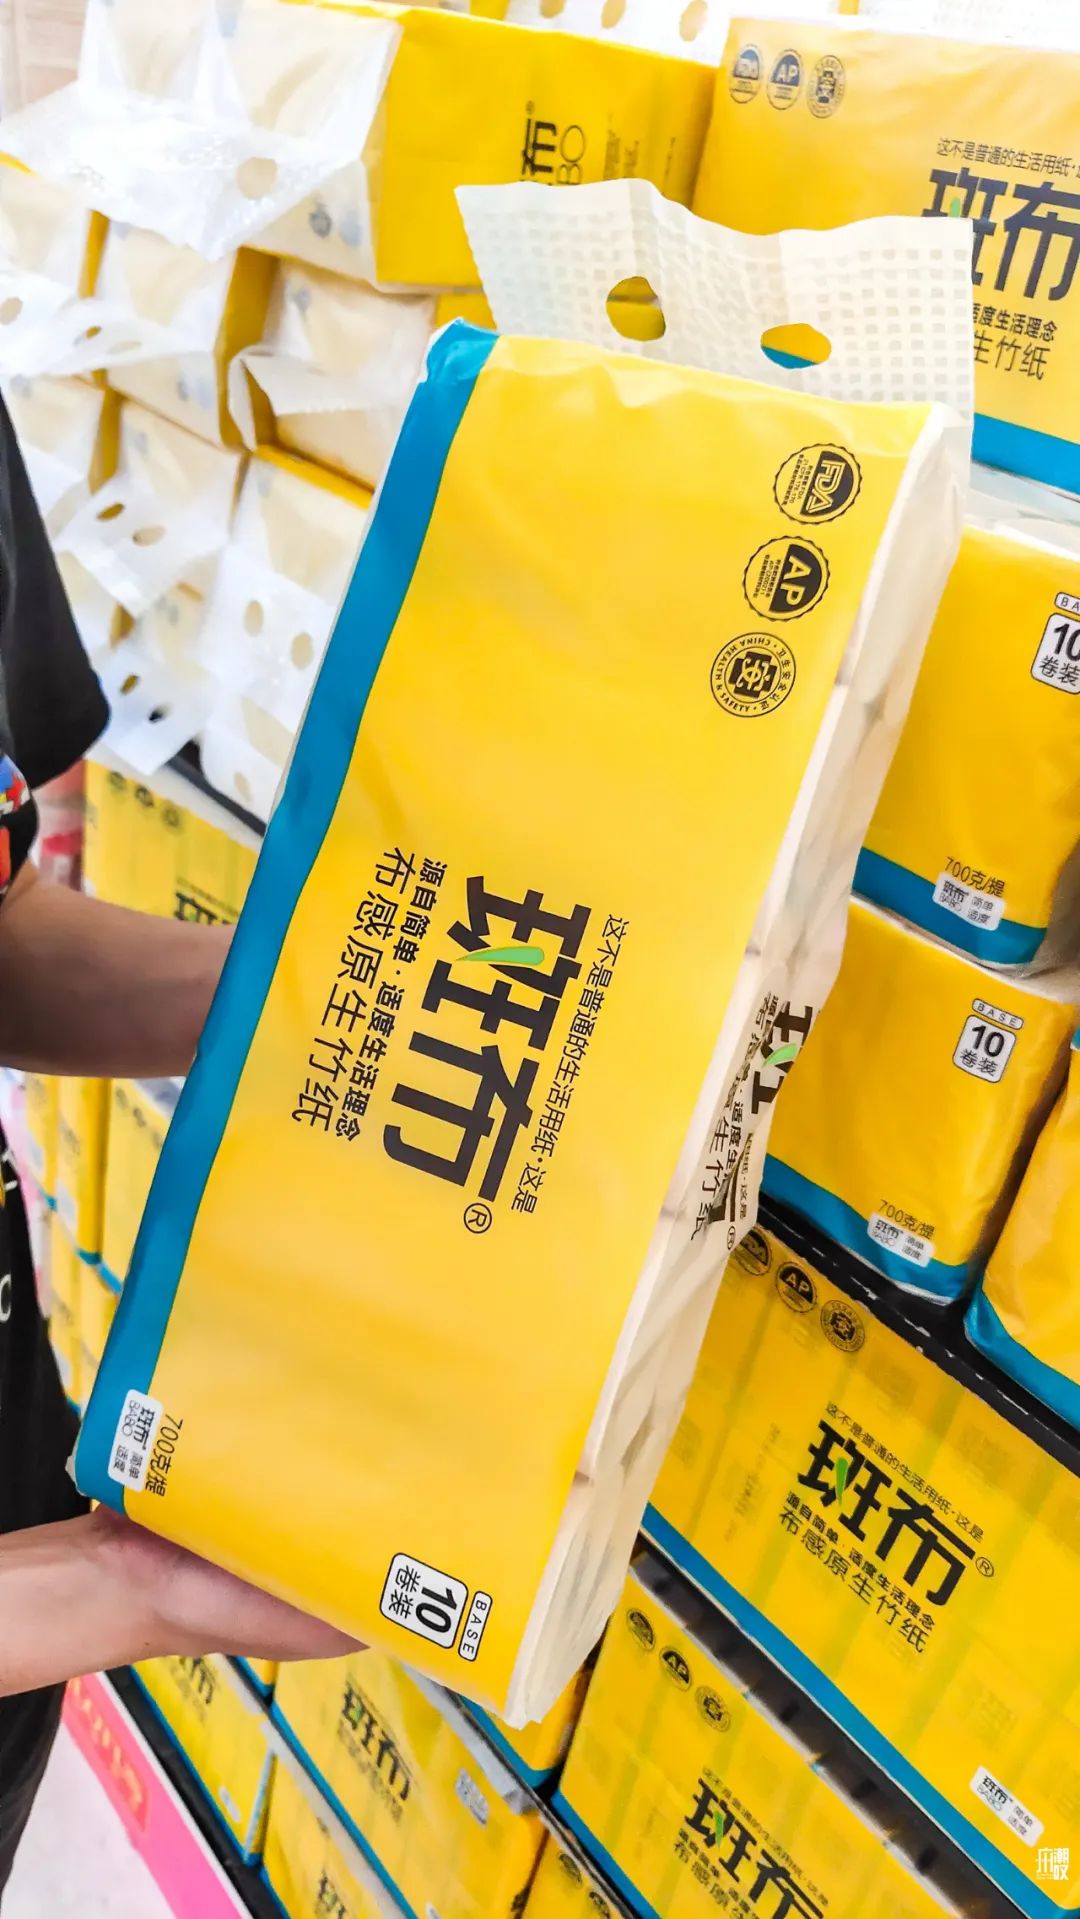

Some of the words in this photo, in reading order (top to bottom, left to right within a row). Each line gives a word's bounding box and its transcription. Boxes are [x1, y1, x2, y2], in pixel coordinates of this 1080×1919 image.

[776, 64, 798, 83] AP
[937, 137, 1080, 179] 这不是普通的生活用纸·
[804, 459, 846, 514] FDA
[780, 555, 812, 606] AP
[715, 645, 738, 681] HEALTH
[739, 637, 771, 647] CHINA
[1053, 623, 1080, 661] 10
[1038, 654, 1080, 687] 卷装
[720, 692, 751, 712] SAFETY
[944, 856, 1006, 898] 700克/提
[291, 847, 416, 1131] 布感原生竹纸
[976, 1002, 1017, 1026] BASE
[383, 876, 592, 1202] 斑布
[972, 1025, 1005, 1057] 10
[511, 913, 630, 1213] 这不是普通的生活用纸·这是
[960, 1048, 999, 1076] 卷装
[878, 1198, 935, 1239] 700克/提
[785, 1272, 810, 1293] AP
[145, 1414, 184, 1496] 700克/提
[797, 1419, 976, 1607] 斑布
[388, 1565, 421, 1619] 卷装
[779, 1504, 930, 1653] 布感原生竹纸
[415, 1587, 457, 1634] 10
[462, 1599, 488, 1654] BASE
